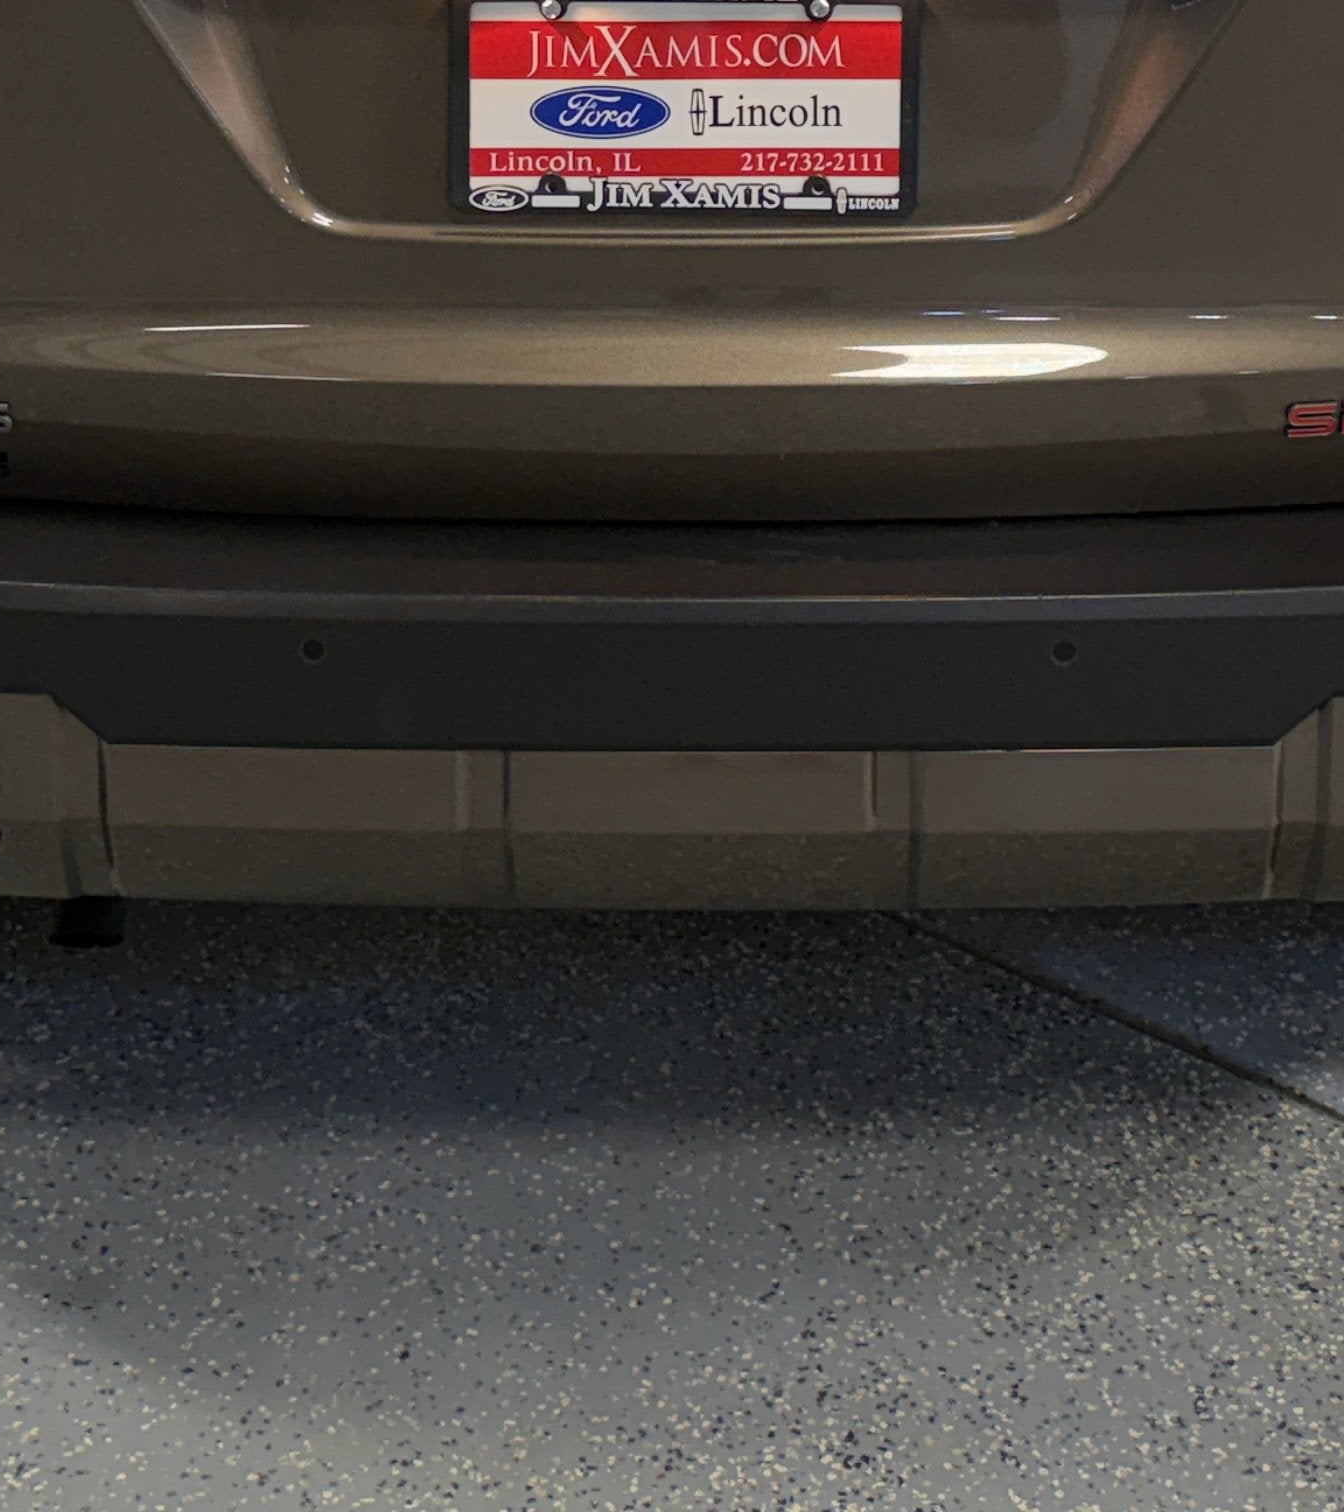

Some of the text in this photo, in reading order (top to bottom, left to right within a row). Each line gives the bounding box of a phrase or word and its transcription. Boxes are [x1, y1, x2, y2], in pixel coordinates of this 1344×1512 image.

[526, 24, 846, 79] JIMXAMIS.COM
[558, 92, 843, 129] Ford Lincoln
[489, 150, 885, 174] Lincoln, IL 217-732-2111
[586, 176, 782, 213] JIM XAMIS
[848, 196, 901, 211] LINCOLN
